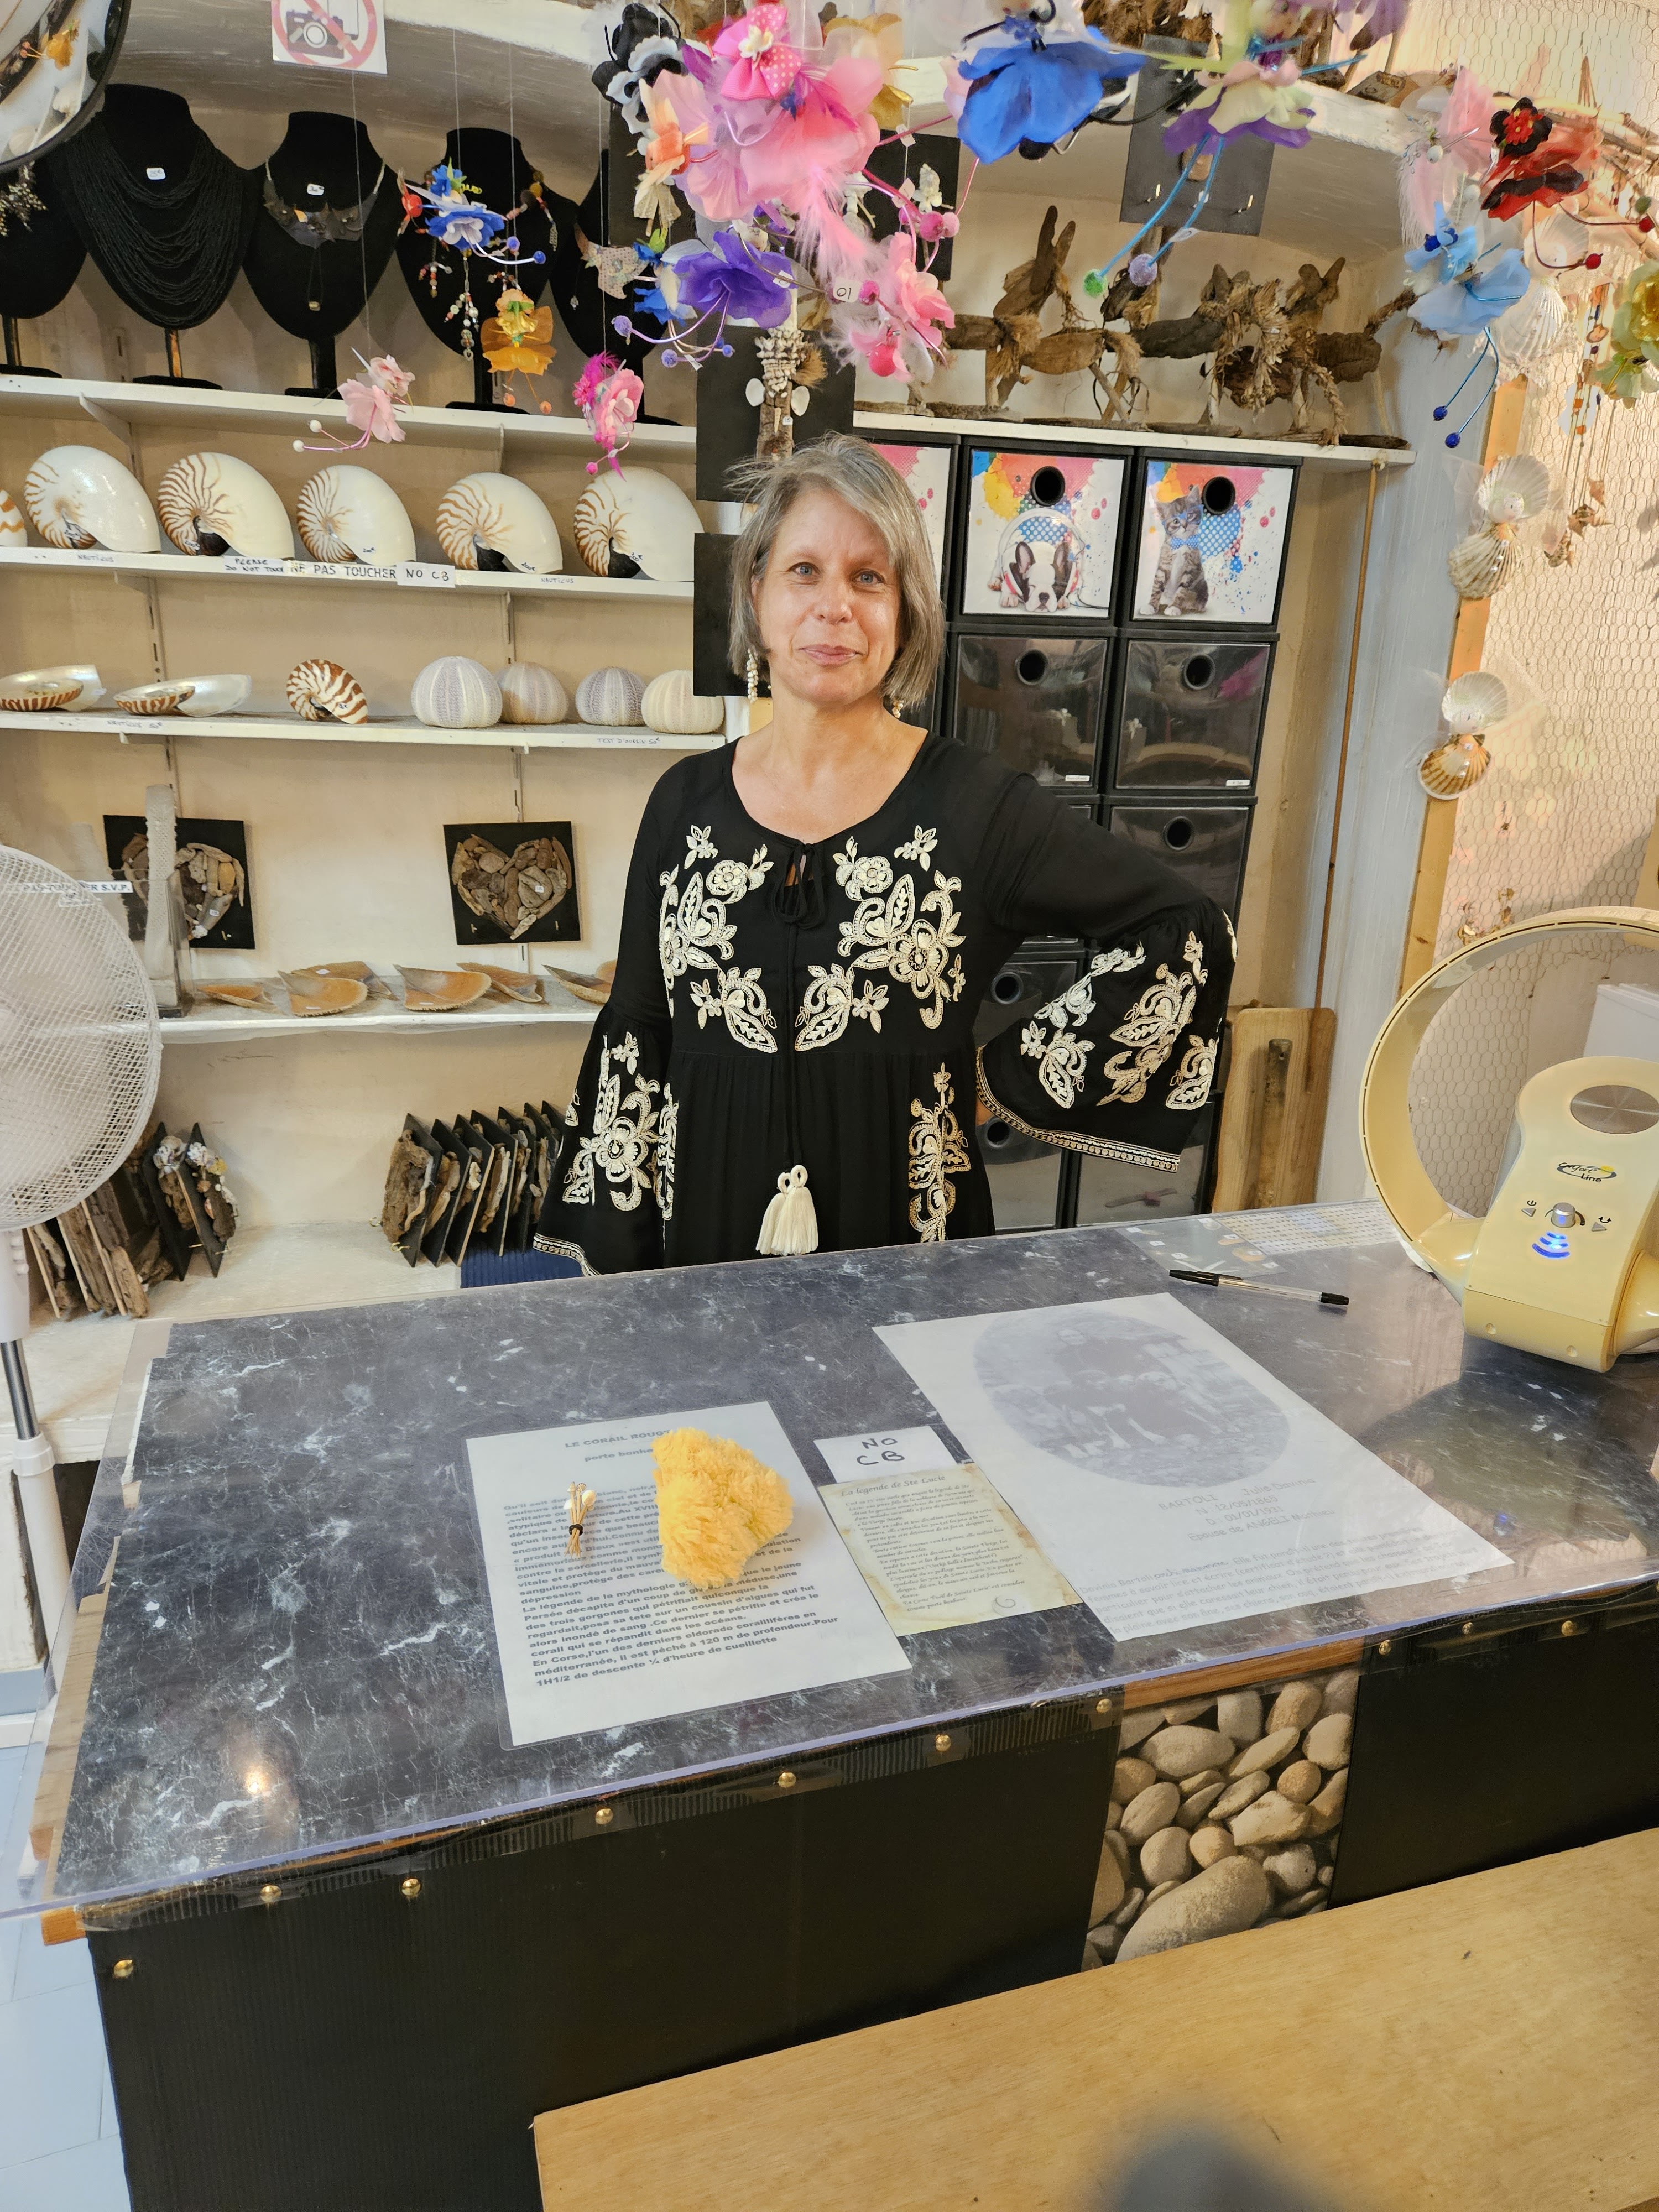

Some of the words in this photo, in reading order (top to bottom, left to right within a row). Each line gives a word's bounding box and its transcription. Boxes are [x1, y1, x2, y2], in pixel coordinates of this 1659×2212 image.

[314, 564, 336, 575] PAS
[343, 566, 397, 579] TOUCHER
[406, 568, 423, 578] NO
[431, 571, 450, 582] CB
[1580, 1173, 1602, 1183] Line
[583, 1436, 628, 1445] CORAIL
[862, 1438, 898, 1449] NO
[584, 1453, 615, 1462] porte
[857, 1451, 905, 1465] CB
[921, 1475, 946, 1483] Lucie
[1159, 1495, 1218, 1510] BARTOLI
[508, 1520, 552, 1530] atypique
[1247, 1516, 1291, 1529] ANGELI
[509, 1528, 548, 1538] déclara
[510, 1538, 539, 1547] qu'un
[512, 1546, 548, 1554] encore
[523, 1551, 560, 1563] produit
[589, 1550, 628, 1559] comme
[516, 1570, 551, 1579] contre
[518, 1579, 549, 1587] vitale
[566, 1569, 607, 1580] protège
[539, 1598, 583, 1610] légende
[616, 1583, 675, 1597] mythologie
[773, 1562, 802, 1572] jeune
[521, 1590, 581, 1604] dépression
[691, 1600, 733, 1610] coussin
[735, 1592, 779, 1603] d'algues
[781, 1587, 798, 1595] qui
[524, 1611, 563, 1621] Persée
[566, 1602, 614, 1614] décapita
[643, 1593, 670, 1601] coup
[549, 1618, 575, 1626] trois
[578, 1609, 629, 1622] gorgones
[633, 1604, 649, 1612] qui
[652, 1595, 699, 1609] pétrifiait
[702, 1587, 756, 1600] quiconque
[529, 1639, 558, 1648] alors
[561, 1630, 599, 1642] inondé
[619, 1623, 647, 1632] sang
[670, 1612, 709, 1623] dernier
[728, 1603, 766, 1614] pétrifia
[530, 1646, 564, 1657] corail
[567, 1642, 585, 1651] qui
[604, 1630, 653, 1644] répandit
[655, 1626, 682, 1634] dans
[703, 1615, 747, 1625] océans.
[635, 1635, 682, 1647] derniers
[685, 1626, 733, 1639] eldorado
[534, 1658, 617, 1677] méditerranée,
[630, 1650, 649, 1658] est
[699, 1636, 720, 1645] 120
[536, 1674, 571, 1686] 1H1/2
[591, 1662, 645, 1676] descente
[662, 1650, 705, 1662] d'heure
[724, 1637, 778, 1650] cueillette
